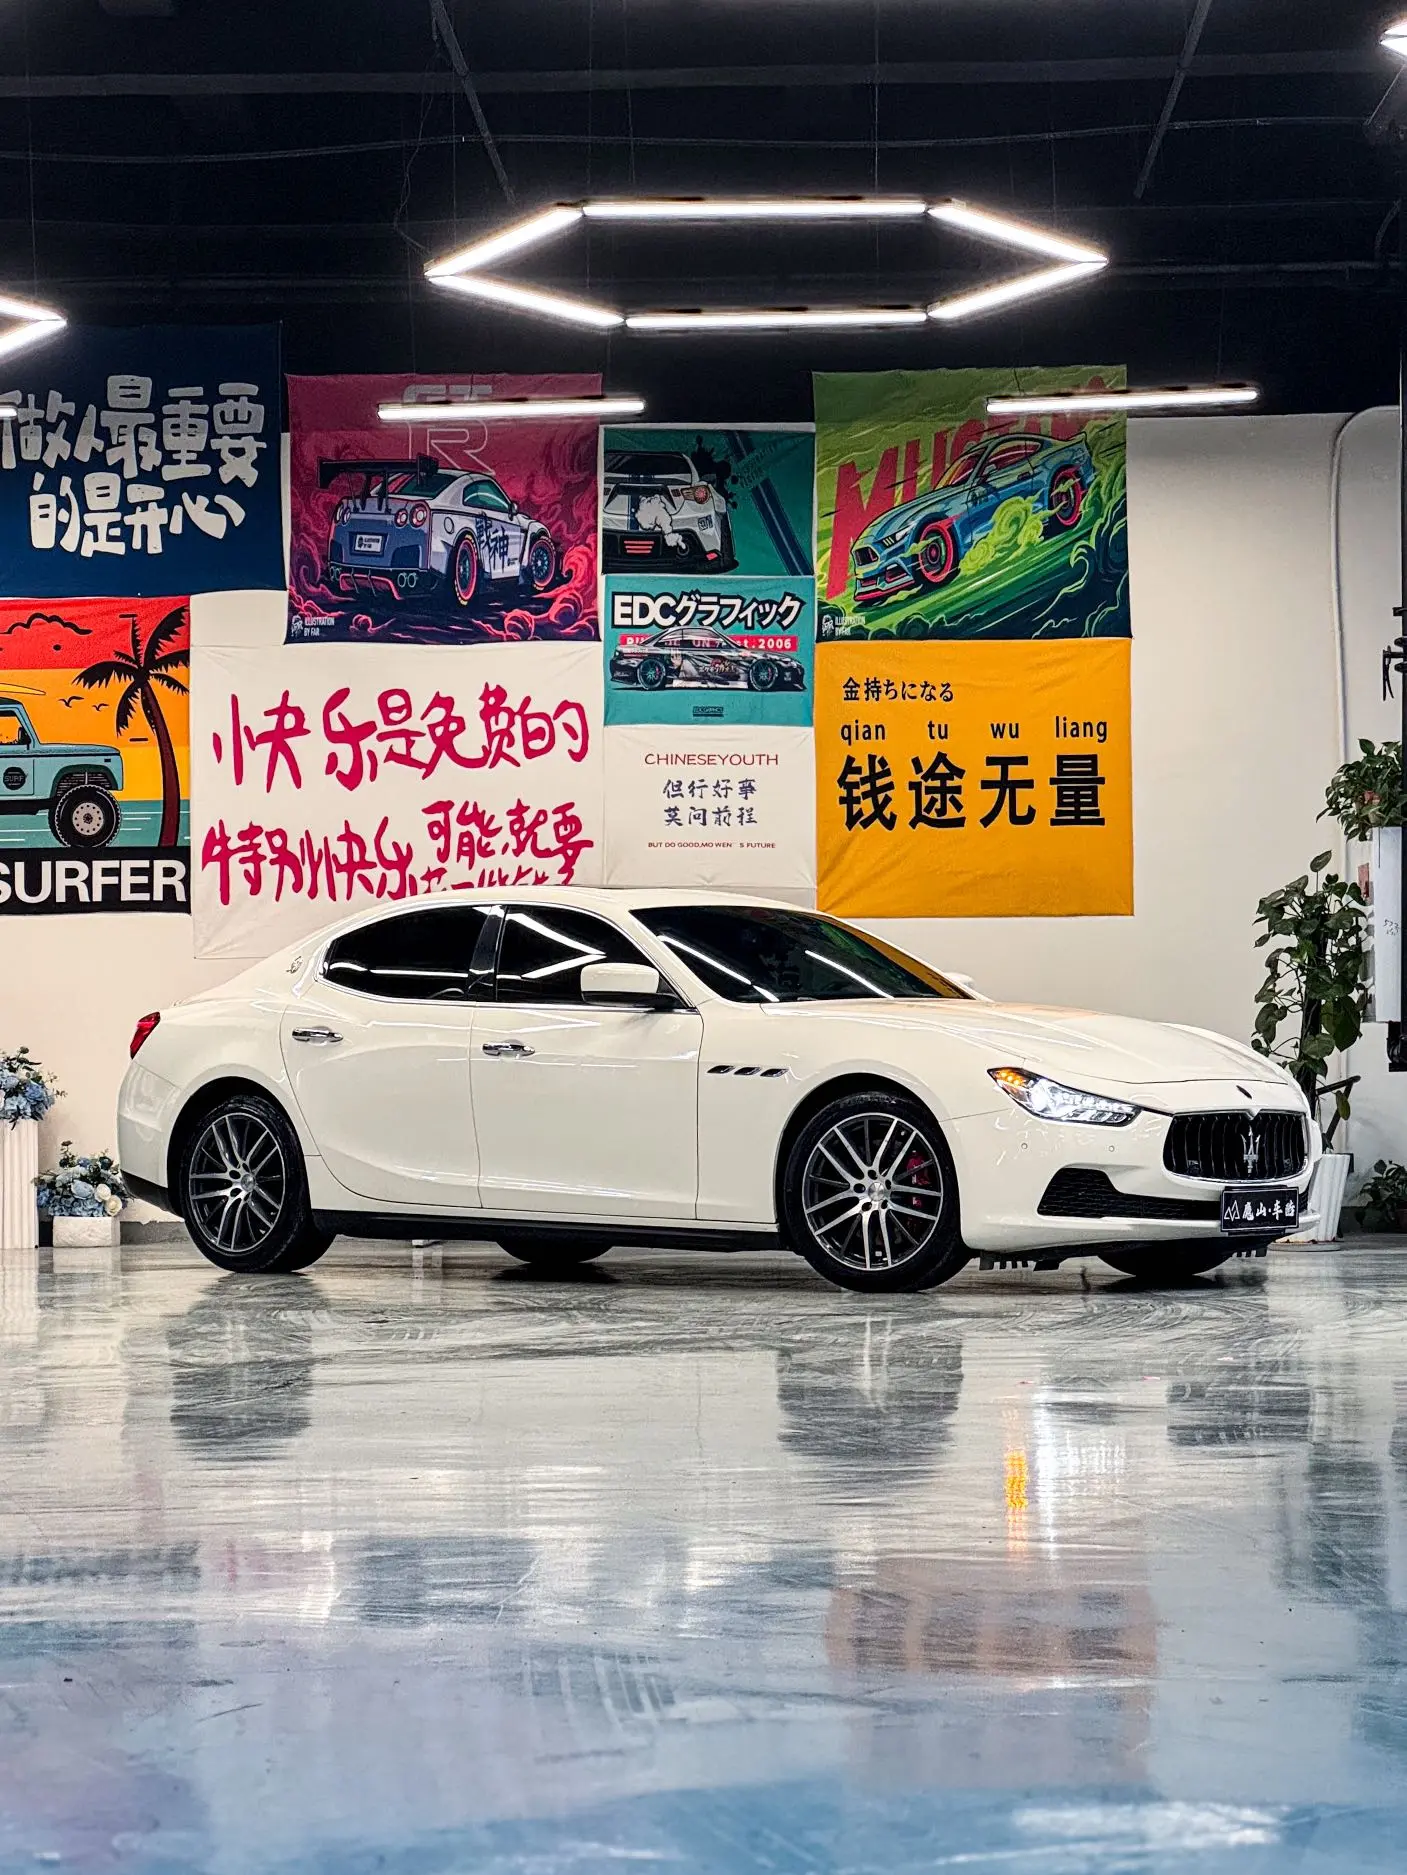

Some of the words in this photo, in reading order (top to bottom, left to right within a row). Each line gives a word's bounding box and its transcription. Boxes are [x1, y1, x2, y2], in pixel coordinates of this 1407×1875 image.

[0, 375, 267, 488] 做人最重要
[29, 471, 246, 558] 的是开心
[842, 677, 954, 702] 金持ちになる
[840, 719, 886, 746] qian
[927, 720, 949, 740] tu
[990, 721, 1020, 739] wu
[1055, 716, 1108, 743] liang
[644, 753, 779, 766] CHINESEYOUTH
[837, 751, 1106, 831] 钱途无量
[663, 805, 758, 827] 莫问前程
